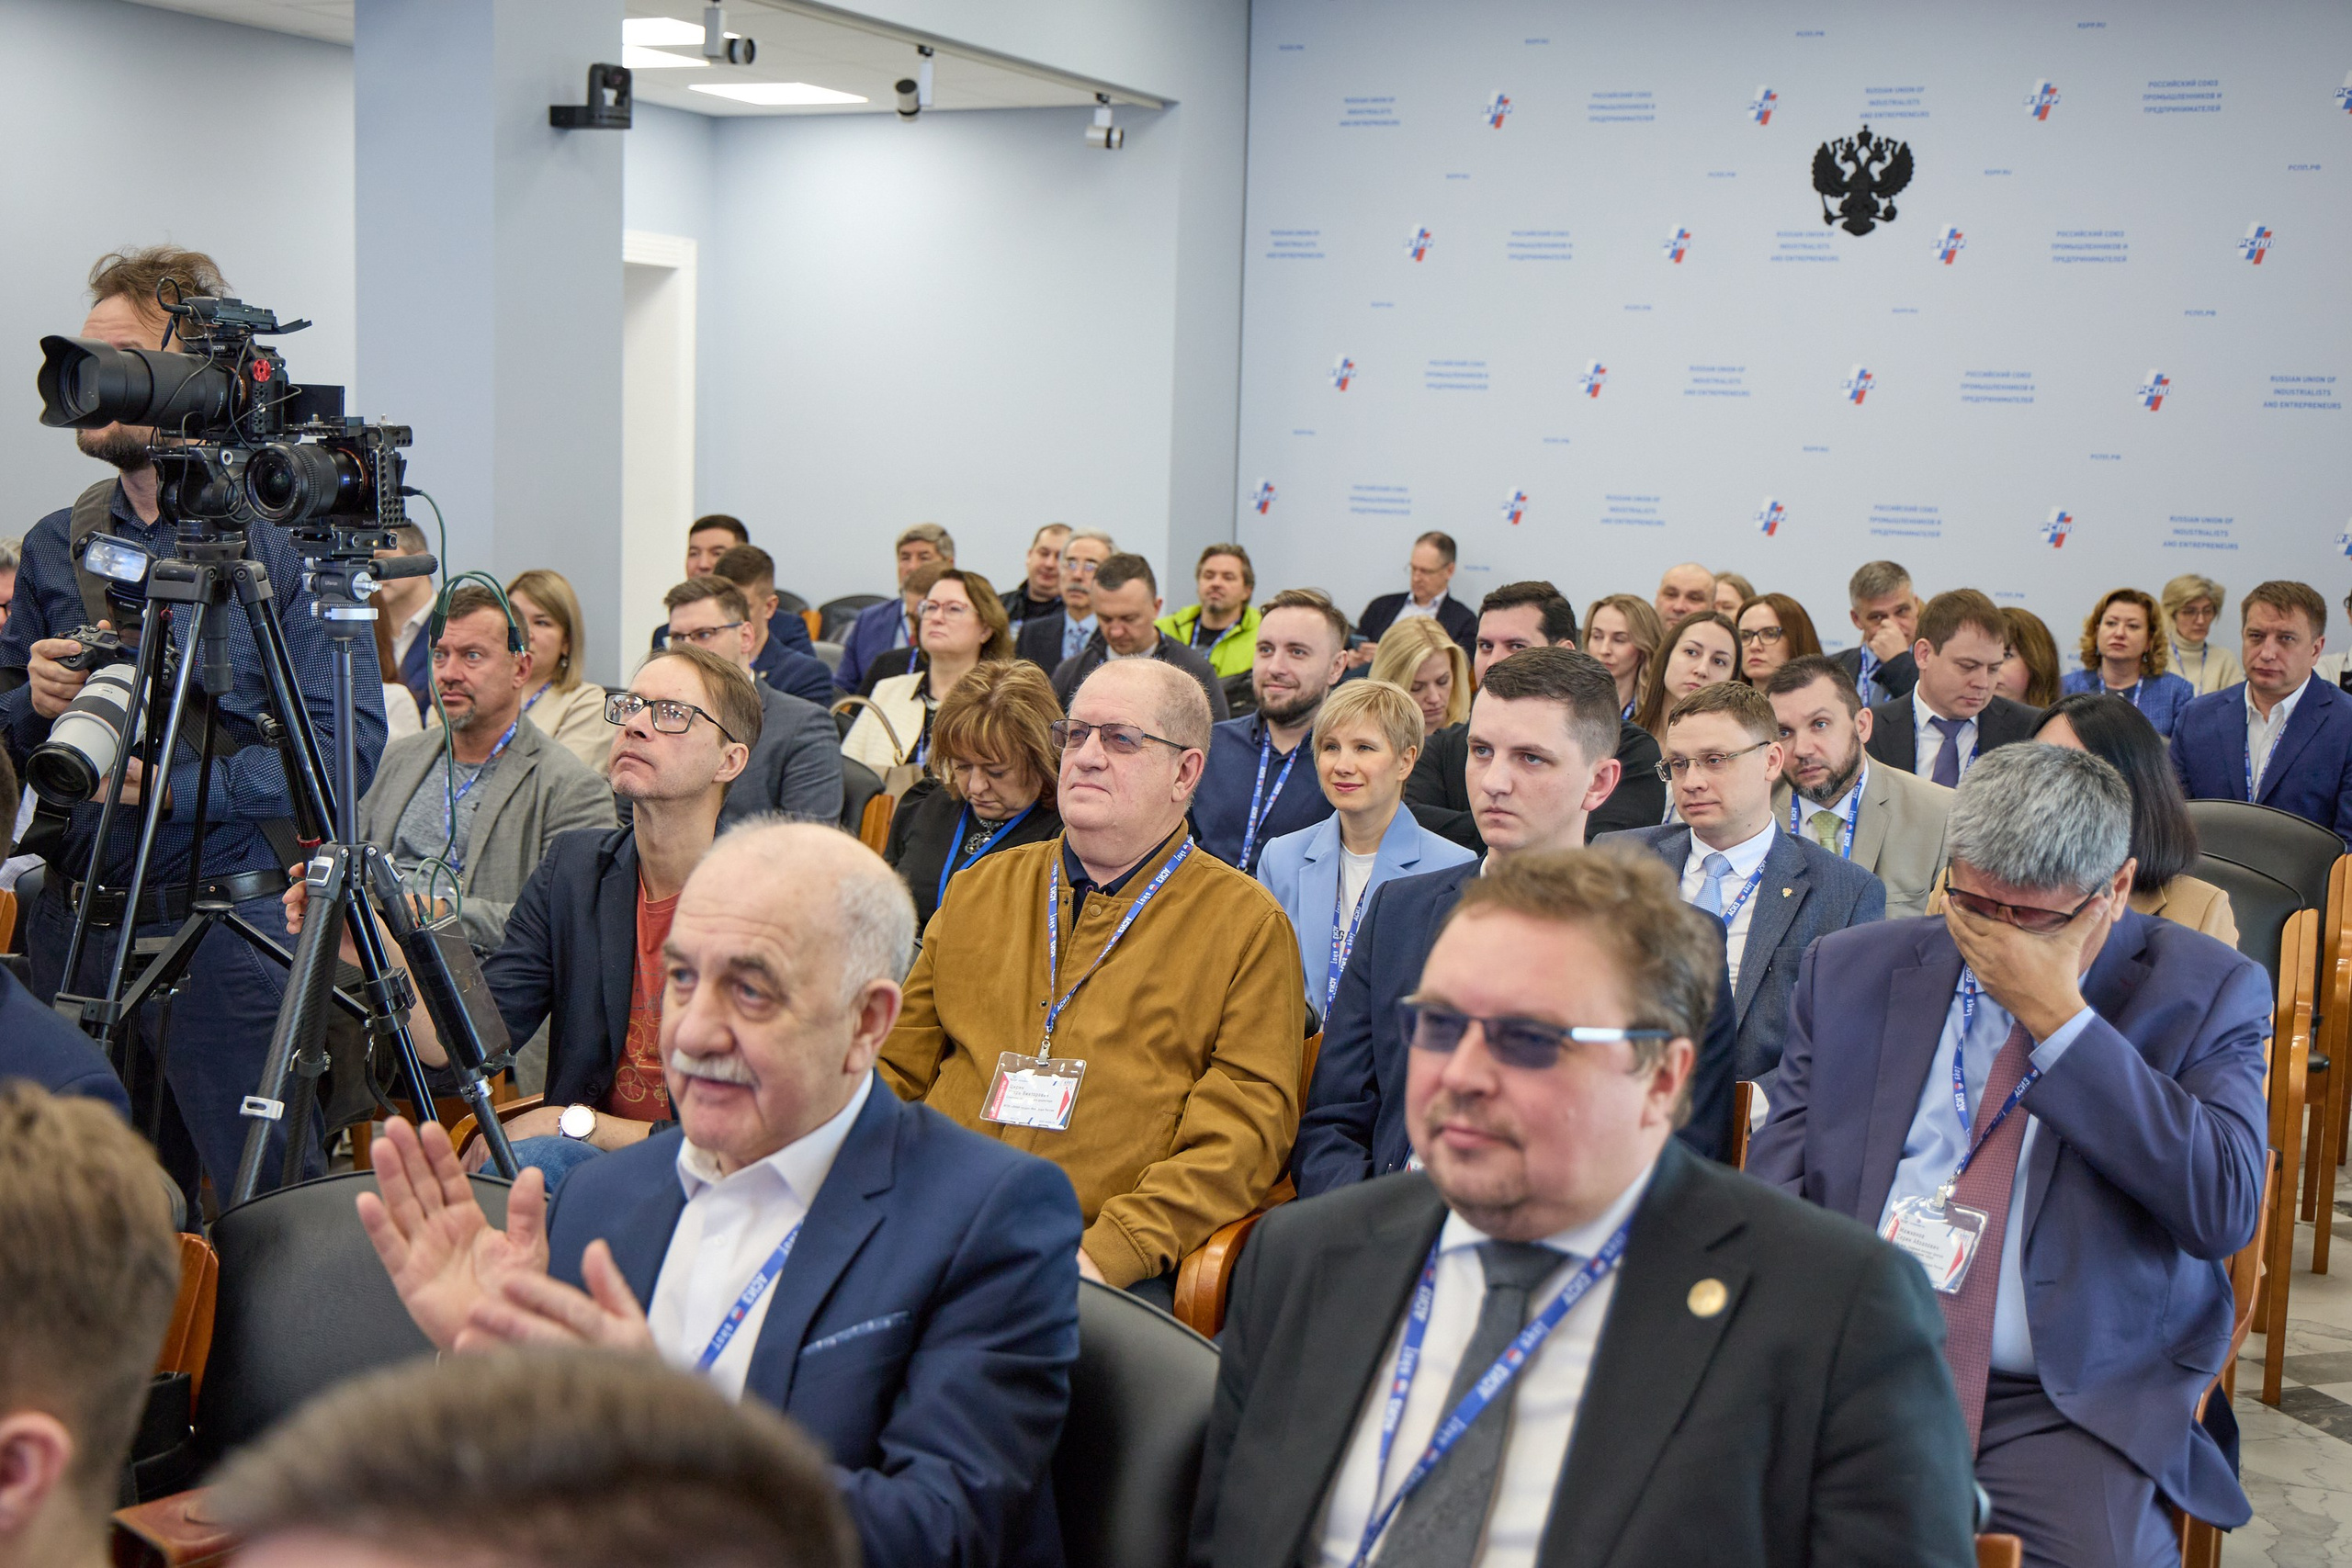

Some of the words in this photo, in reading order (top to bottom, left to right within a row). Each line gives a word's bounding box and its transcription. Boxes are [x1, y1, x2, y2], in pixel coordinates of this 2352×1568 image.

[2237, 239, 2275, 249] РСПП
[2269, 375, 2301, 383] RUSSIAN
[2301, 375, 2324, 383] UNION
[2326, 375, 2336, 383] OF
[2273, 388, 2331, 397] INDUSTRIALISTS
[2263, 400, 2277, 410] AND
[2279, 400, 2342, 410] ENTREPRENEURS
[1155, 867, 1171, 884] АСИЗ
[1726, 902, 1741, 917] АСИЗ
[2013, 1077, 2031, 1099] АСИЗ
[1957, 1092, 1965, 1112] АСИЗ
[1476, 1364, 1510, 1401] АСИЗ
